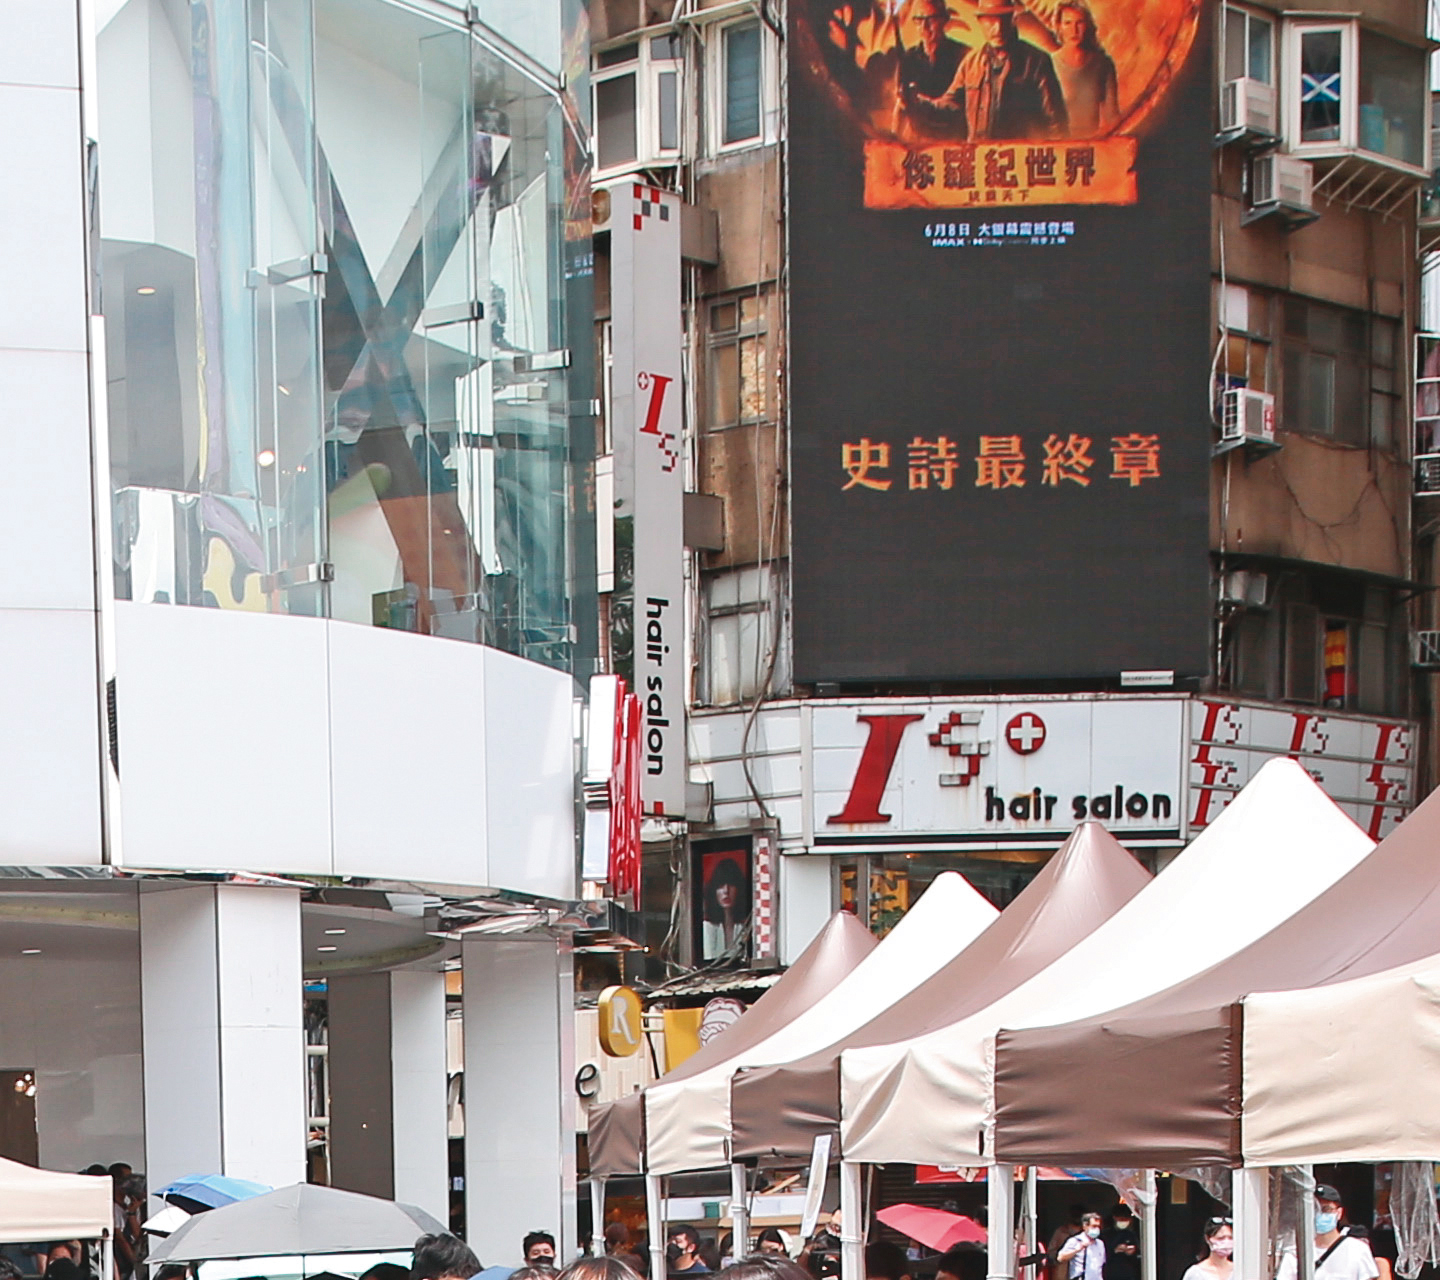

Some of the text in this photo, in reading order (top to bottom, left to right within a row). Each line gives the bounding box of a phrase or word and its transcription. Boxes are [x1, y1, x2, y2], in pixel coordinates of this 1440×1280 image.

[902, 146, 1097, 190] 侏羅紀世界
[841, 433, 1162, 492] 史詩最終章
[646, 597, 670, 776] hair salon
[985, 785, 1172, 823] hair salon
[611, 996, 637, 1045] R
